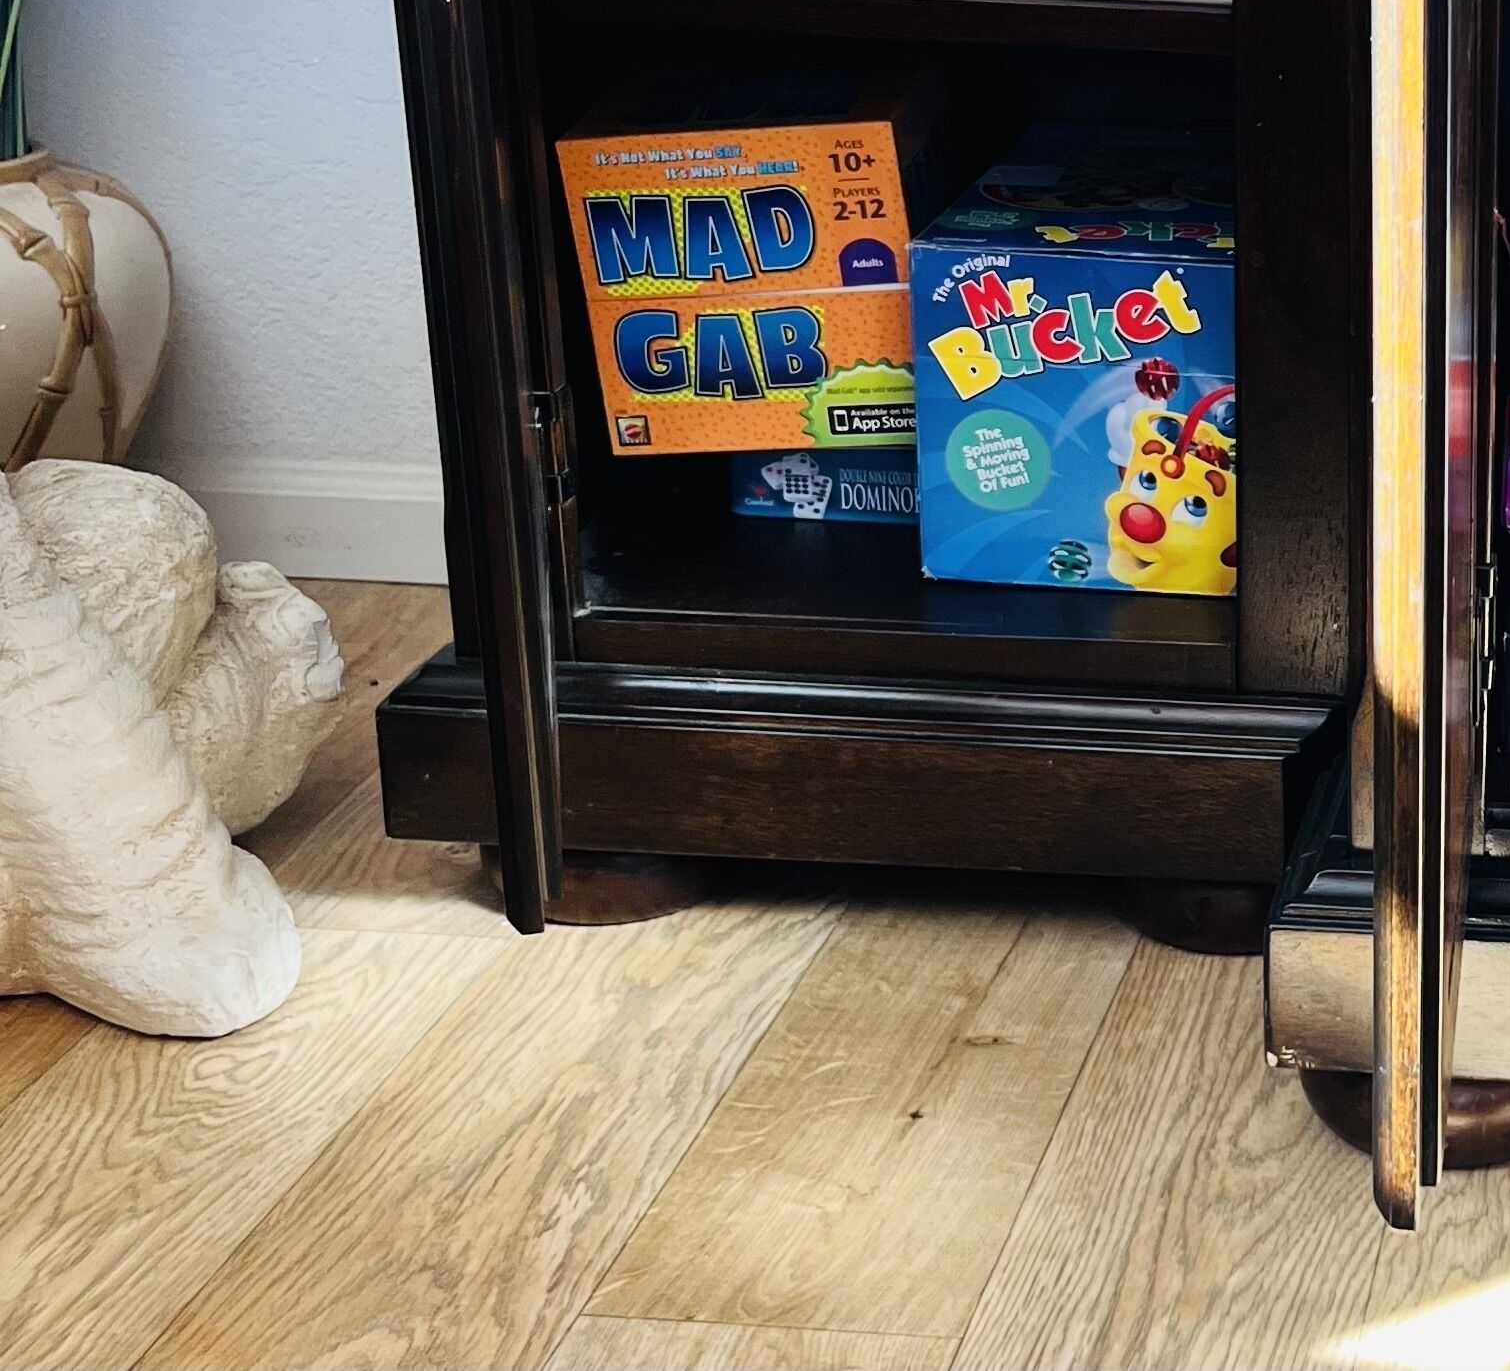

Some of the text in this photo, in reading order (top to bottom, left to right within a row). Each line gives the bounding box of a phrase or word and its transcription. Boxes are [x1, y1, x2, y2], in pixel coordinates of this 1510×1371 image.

[596, 152, 618, 165] It's
[649, 148, 684, 163] What
[687, 146, 713, 160] You
[828, 152, 875, 173] 10+
[665, 168, 688, 180] It's
[690, 166, 727, 179] What
[730, 164, 755, 176] You
[832, 198, 886, 221] 2-12
[583, 184, 815, 286] MAD
[852, 258, 884, 268] Adults
[932, 253, 1011, 304] The Original
[958, 270, 1047, 330] Mr.
[928, 269, 1202, 401] Bucket
[614, 305, 828, 401] GAB
[850, 408, 887, 417] Available
[852, 415, 918, 432] App Store
[975, 428, 1003, 441] The
[962, 436, 1024, 458] Spinning
[966, 448, 1030, 470] & Moving
[977, 461, 1026, 481] Bucket
[980, 471, 1030, 493] Of Fun!
